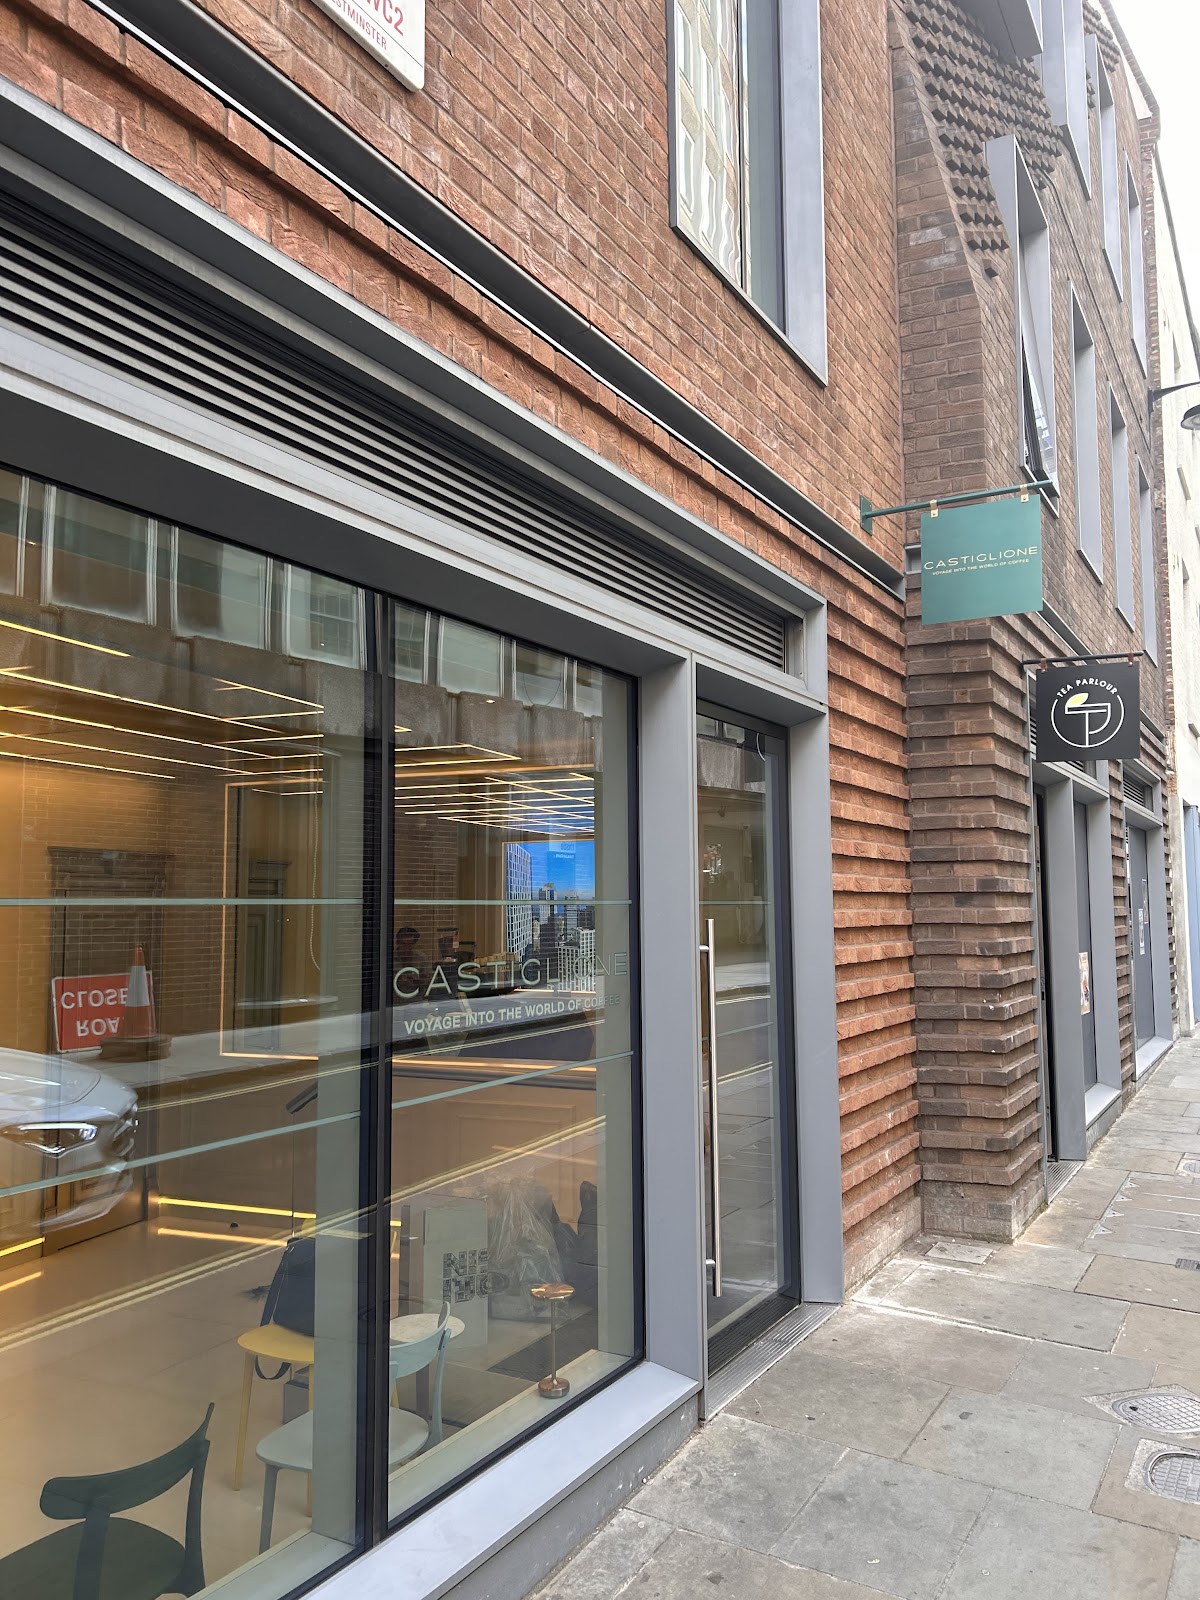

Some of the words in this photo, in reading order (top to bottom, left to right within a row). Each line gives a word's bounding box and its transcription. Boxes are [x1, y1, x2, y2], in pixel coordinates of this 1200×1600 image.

[332, 0, 387, 50] STMINSTER
[366, 0, 404, 36] C2
[924, 546, 1038, 570] CASTIGLIONE
[1056, 684, 1074, 698] TEA
[1076, 678, 1118, 695] PARLOUR
[404, 1015, 460, 1035] VOYAGE
[465, 1010, 495, 1027] INTO
[498, 1003, 522, 1021] THE
[525, 1001, 565, 1017] WORLD
[568, 999, 582, 1011] OF
